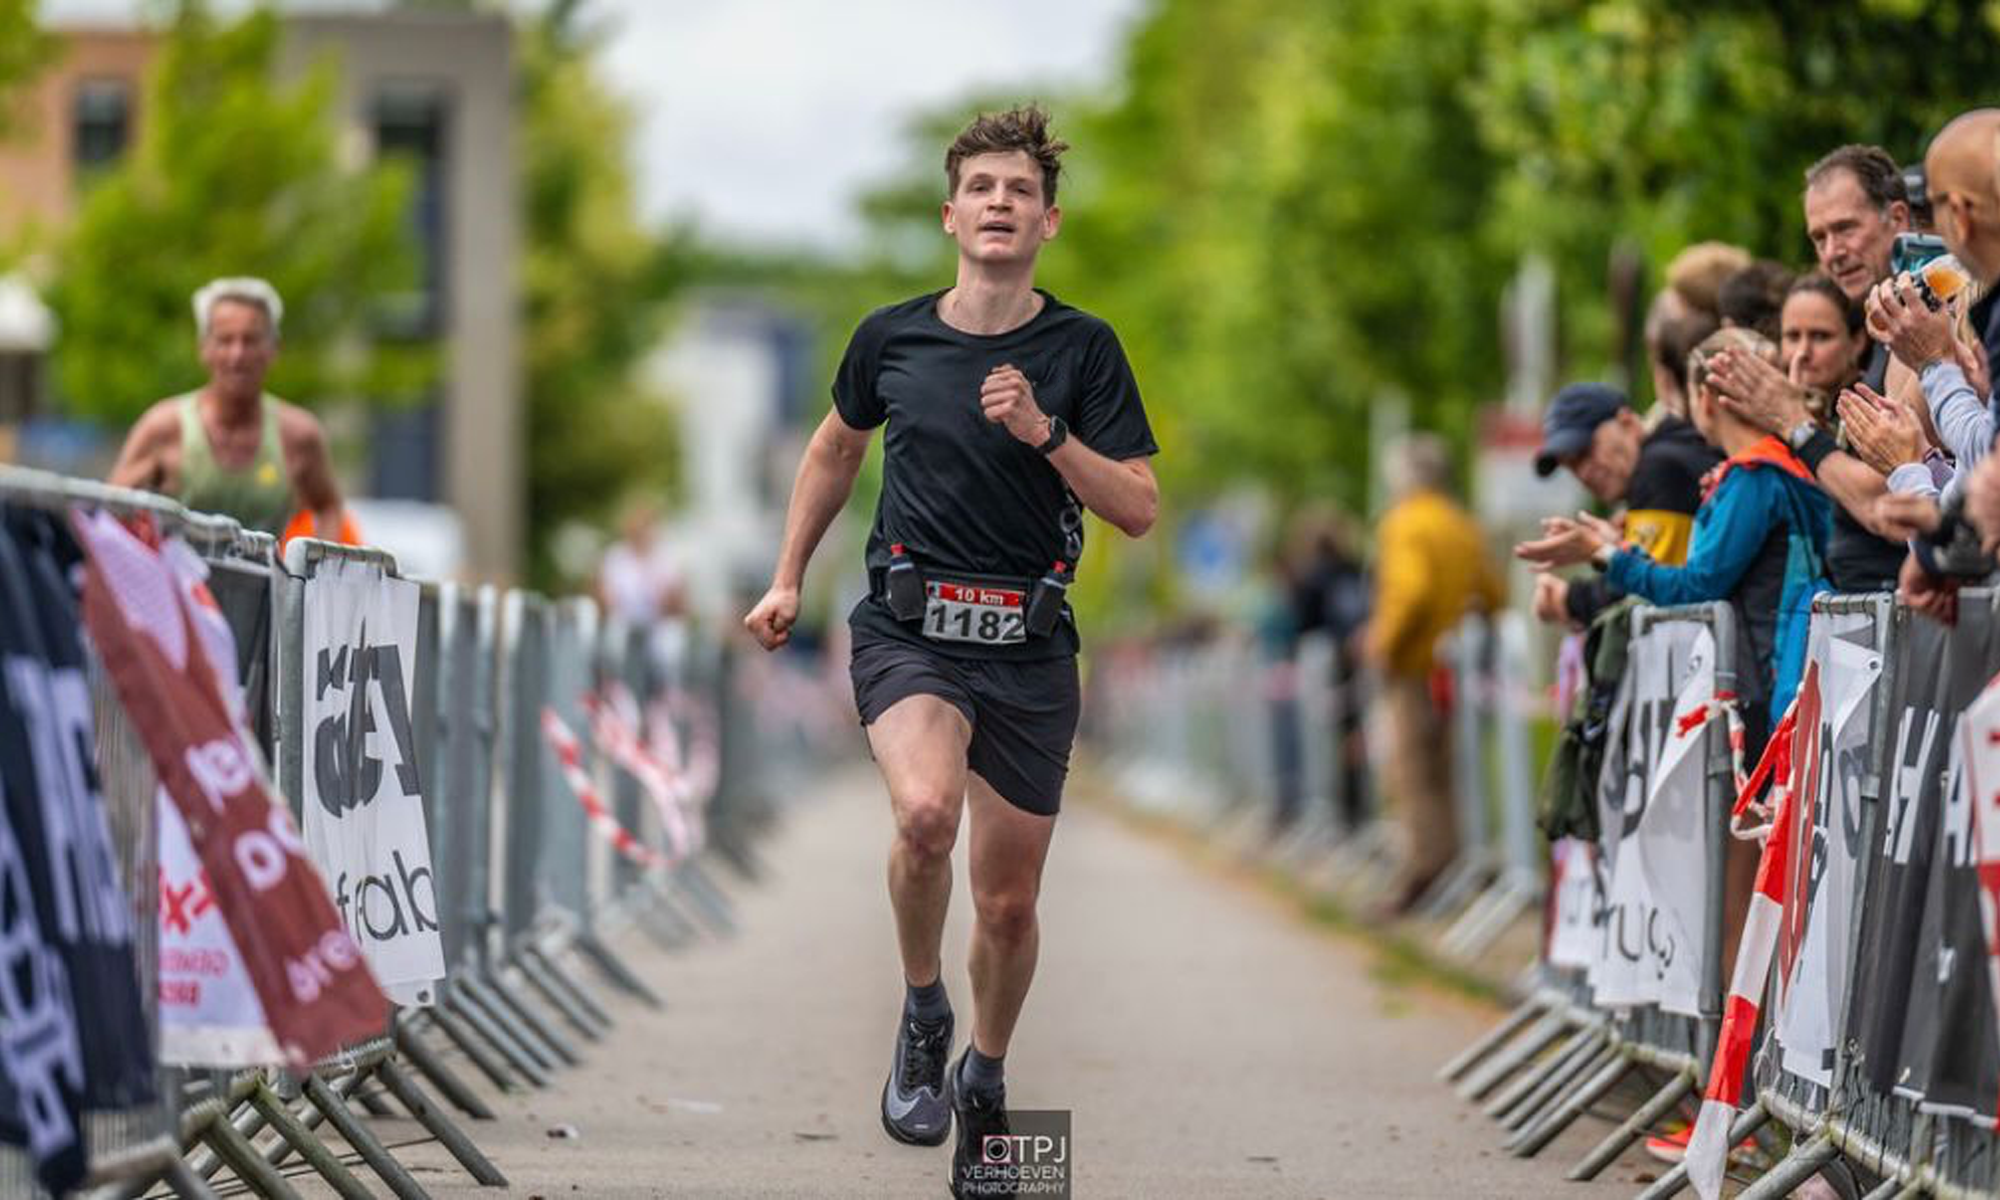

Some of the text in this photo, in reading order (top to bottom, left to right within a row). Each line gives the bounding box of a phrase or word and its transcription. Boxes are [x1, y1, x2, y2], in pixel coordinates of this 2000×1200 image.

[955, 588, 1004, 605] 10 km
[931, 604, 1025, 640] 1182
